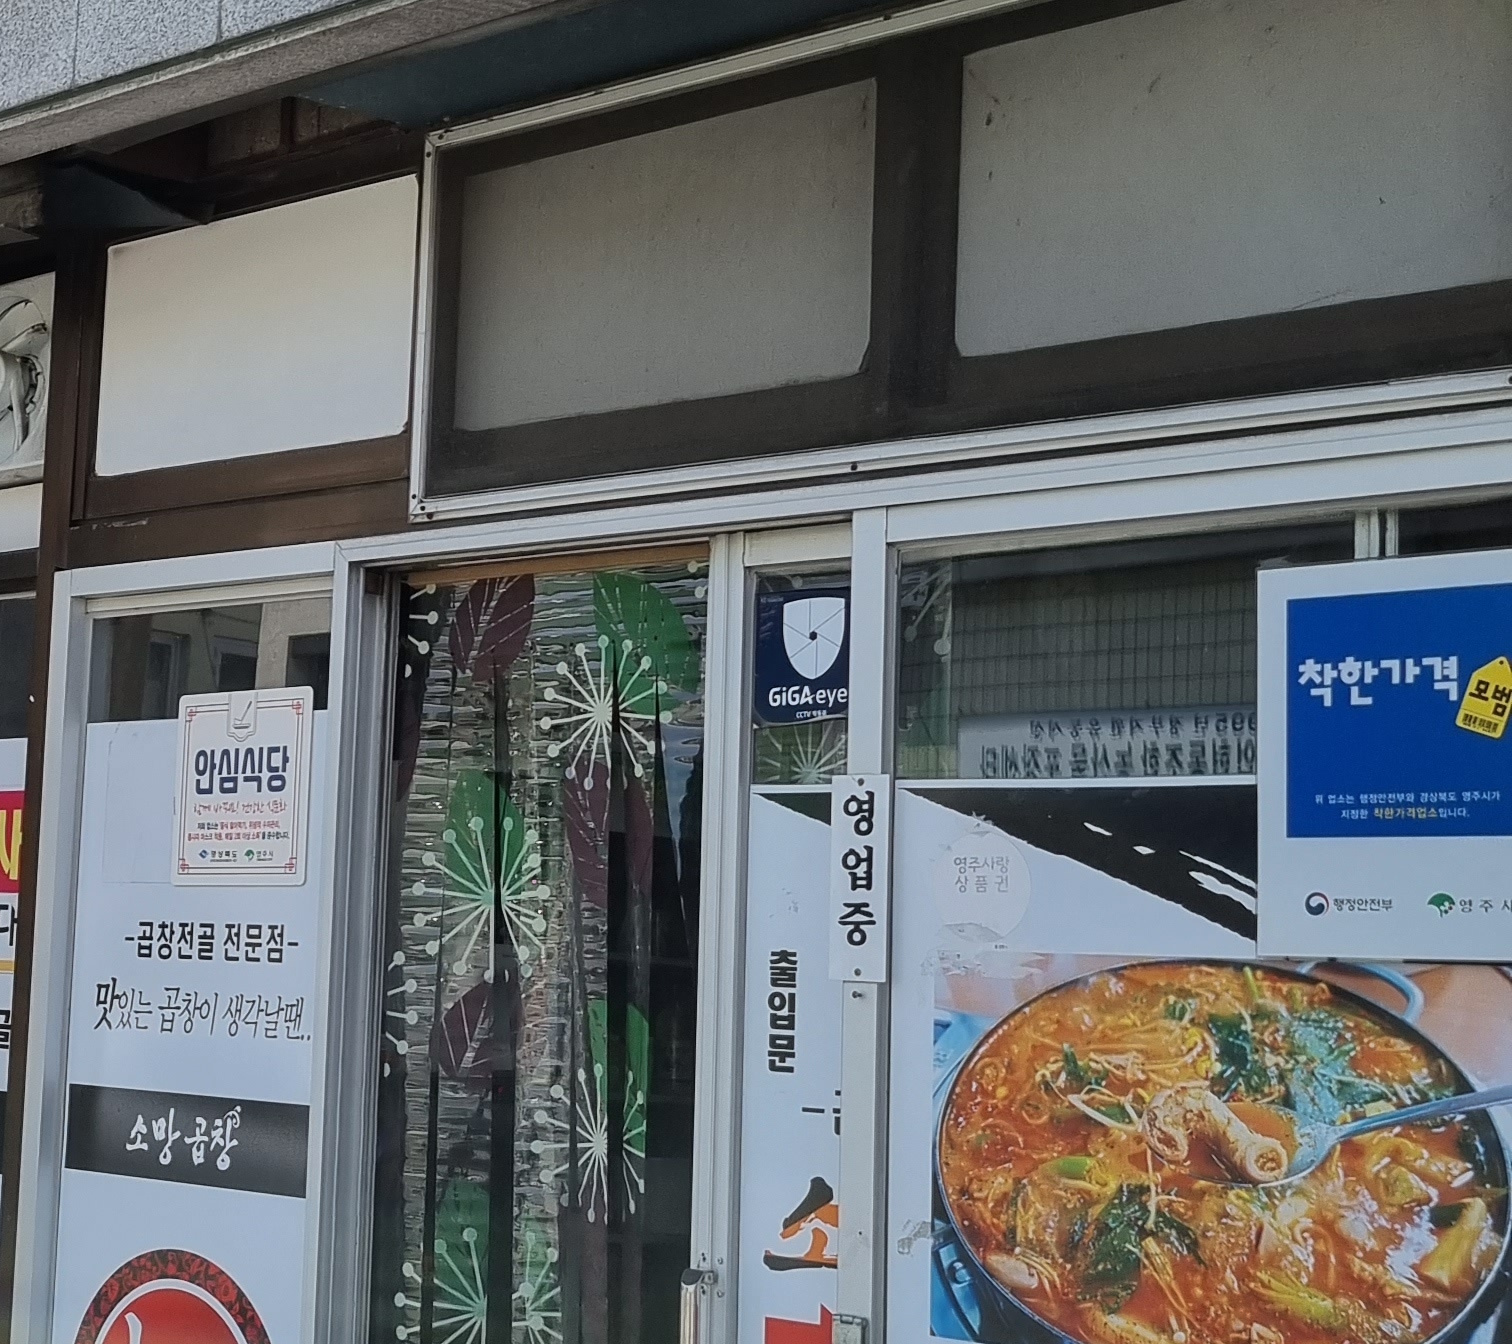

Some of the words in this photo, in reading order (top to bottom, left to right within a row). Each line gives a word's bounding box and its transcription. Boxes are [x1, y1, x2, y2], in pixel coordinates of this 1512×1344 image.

[1297, 656, 1458, 707] 착한가격
[194, 745, 290, 795] 안심식당
[838, 791, 877, 947] 영업중
[953, 856, 1010, 874] 영주사랑
[1333, 897, 1394, 912] 행정안전부
[94, 977, 153, 1031] 맛있는
[157, 986, 218, 1038] 곱창이
[767, 949, 798, 1074] 출입문
